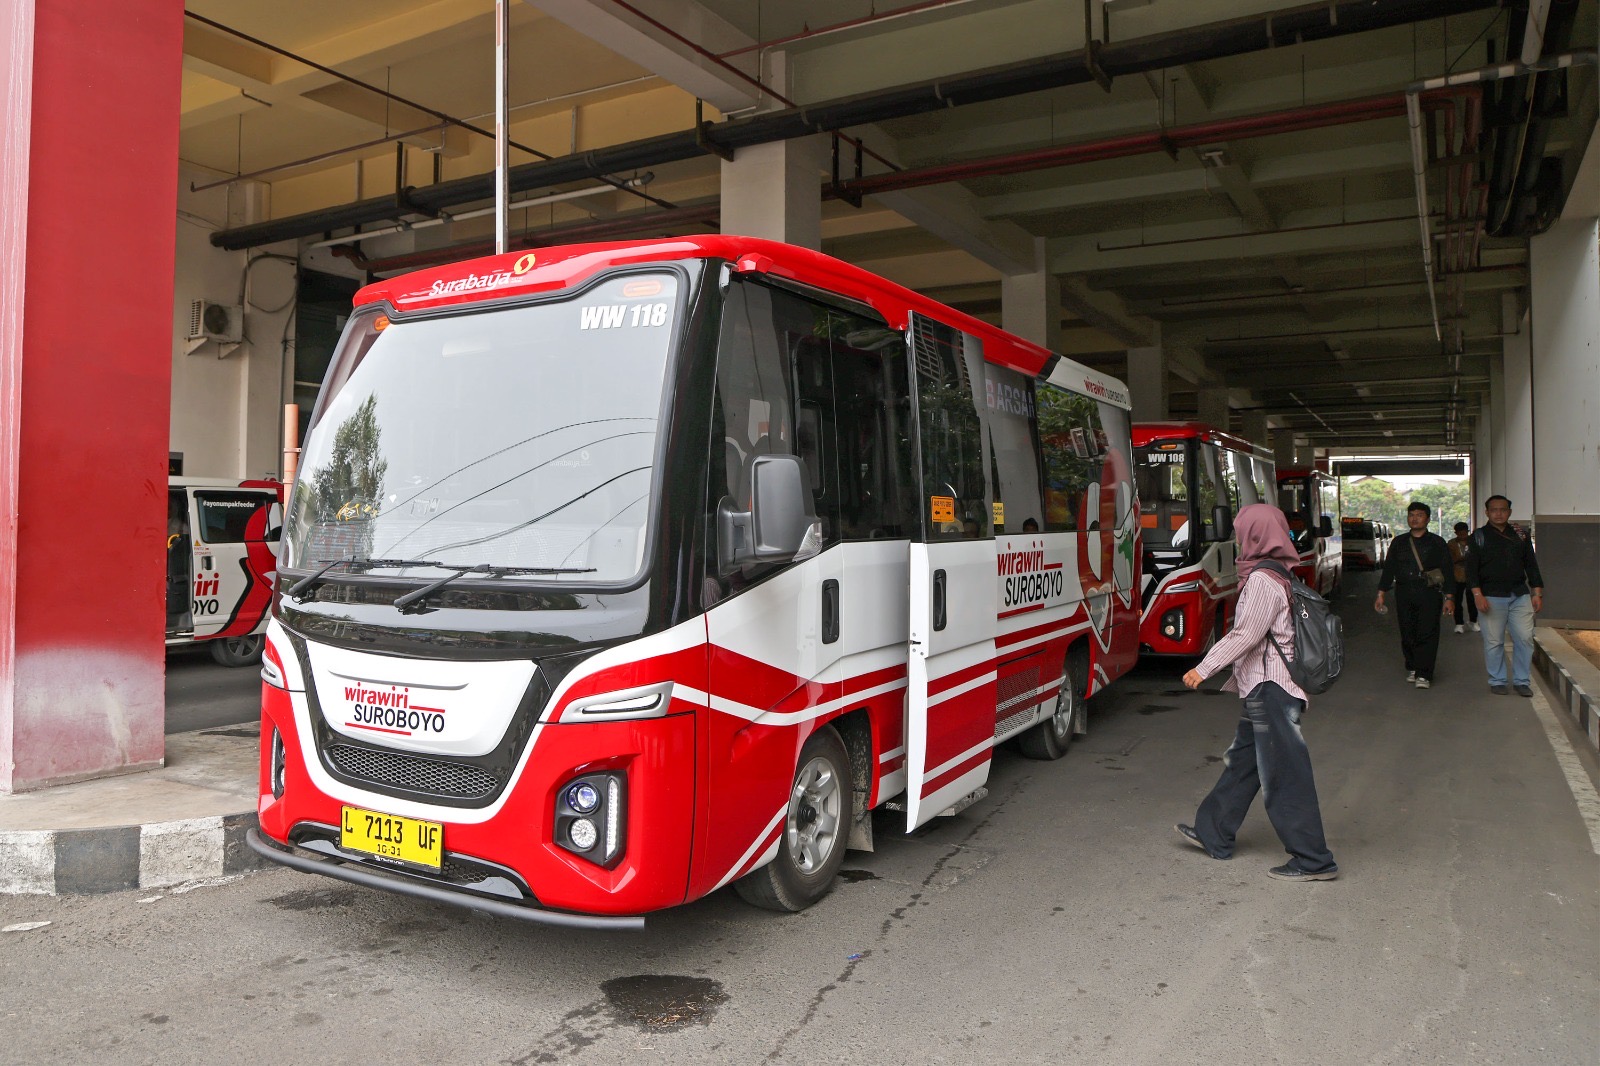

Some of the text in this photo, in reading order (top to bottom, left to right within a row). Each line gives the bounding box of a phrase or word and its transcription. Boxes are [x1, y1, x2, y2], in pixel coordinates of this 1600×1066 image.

[428, 273, 512, 297] Surabaya
[580, 302, 668, 331] WW 118
[1147, 453, 1185, 463] WW 108
[202, 499, 256, 509] #ayonumpakfeeder
[996, 539, 1044, 577] wirawiri
[194, 572, 220, 597] iri
[1004, 570, 1063, 607] SUROBOYO
[344, 681, 409, 709] wirawiri
[353, 703, 445, 733] SUROBOYO
[345, 810, 438, 851] L 7113 UF
